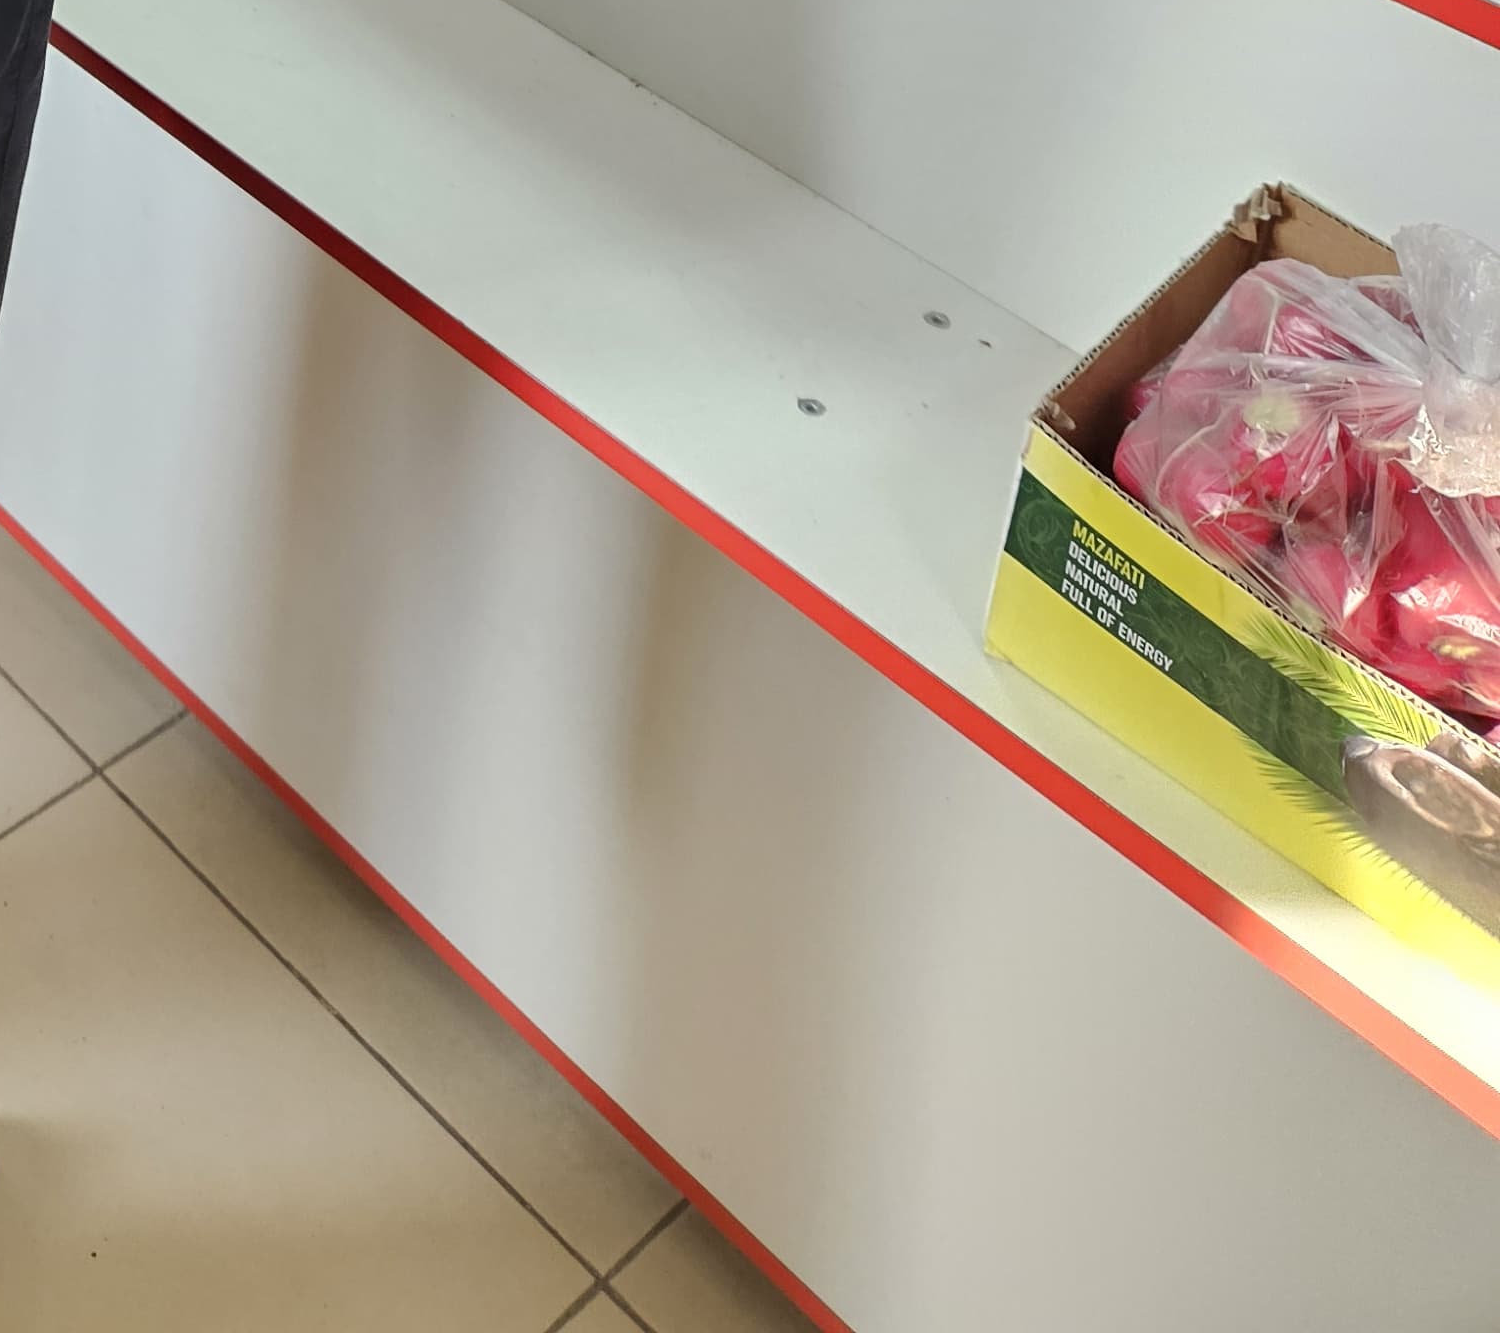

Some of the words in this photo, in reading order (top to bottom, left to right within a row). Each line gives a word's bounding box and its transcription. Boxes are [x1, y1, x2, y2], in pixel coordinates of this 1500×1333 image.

[1065, 561, 1124, 617] NATURAL
[1068, 540, 1138, 606] DELICIOUS
[1073, 520, 1145, 590] MAZAFATI
[1061, 578, 1094, 615] FULL
[1097, 606, 1117, 628] OF
[1118, 622, 1174, 672] ENERGY
